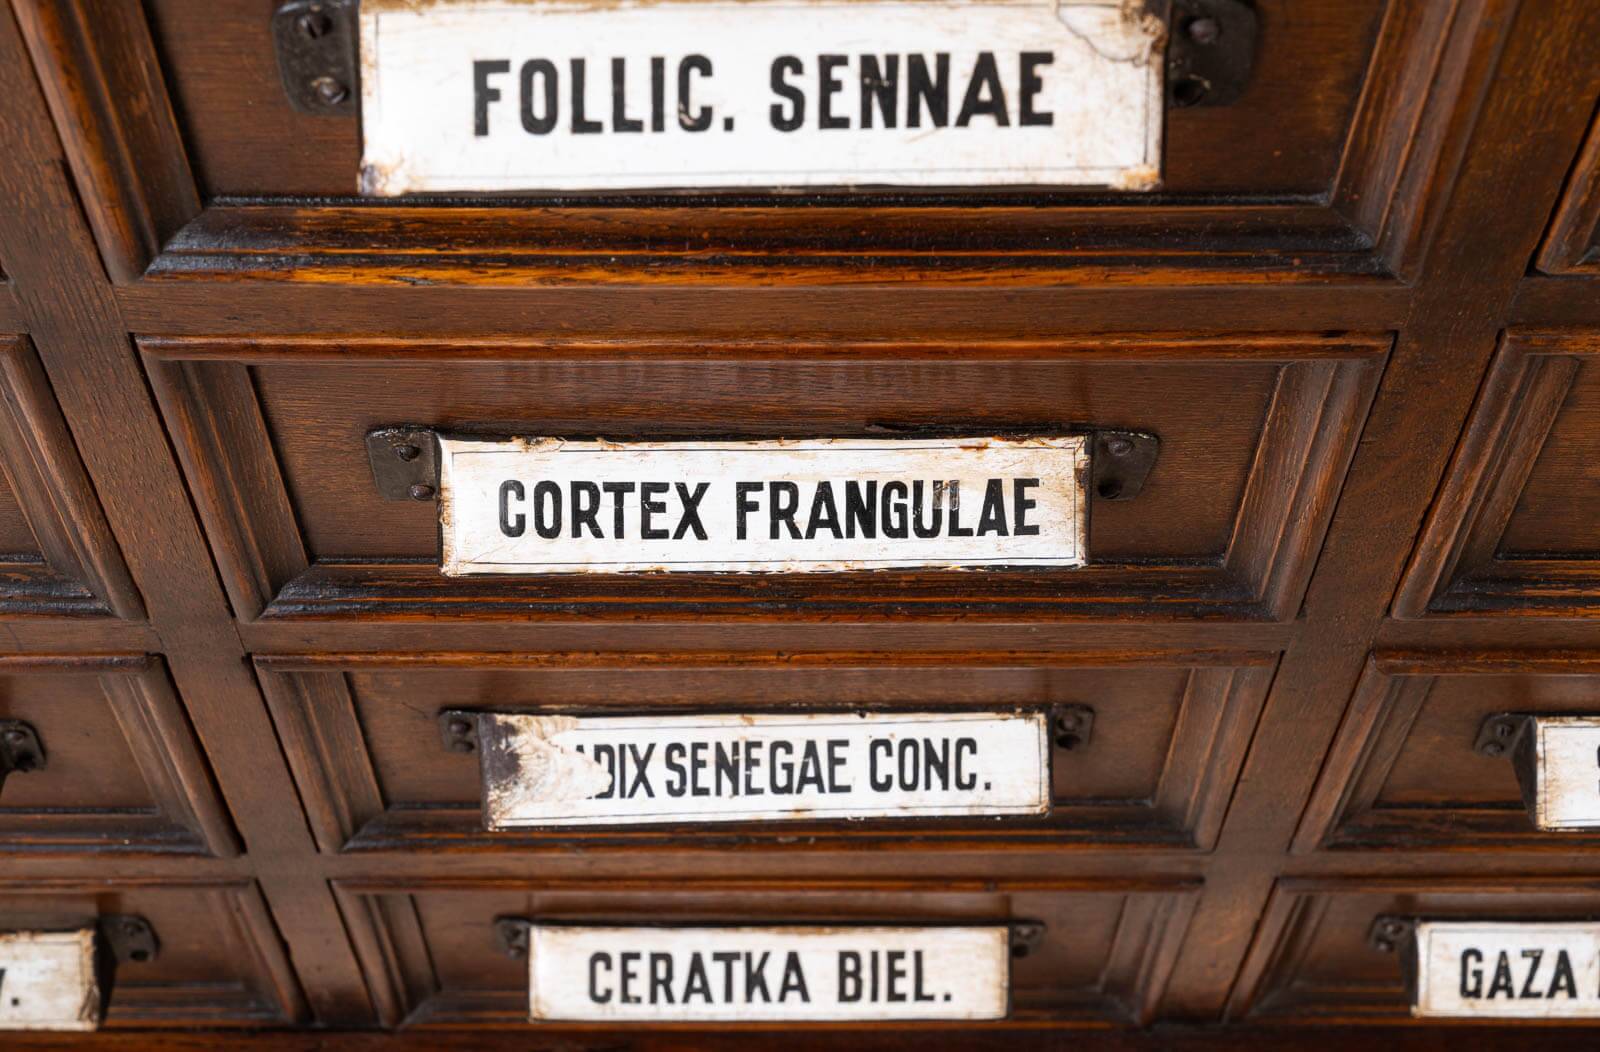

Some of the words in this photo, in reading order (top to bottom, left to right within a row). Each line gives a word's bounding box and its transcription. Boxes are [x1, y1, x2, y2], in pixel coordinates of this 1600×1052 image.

[473, 54, 734, 136] FOLLIC.
[770, 51, 1055, 132] SENNAE
[499, 479, 711, 540] CORTEX
[735, 477, 1040, 539] FRANGULAE
[575, 743, 656, 799] DIX
[665, 739, 852, 797] SENEGAE
[869, 737, 992, 793] CONC.
[588, 951, 811, 1004] CERATKA
[837, 950, 952, 1003] BIEL.
[1459, 948, 1578, 1000] GAZA
